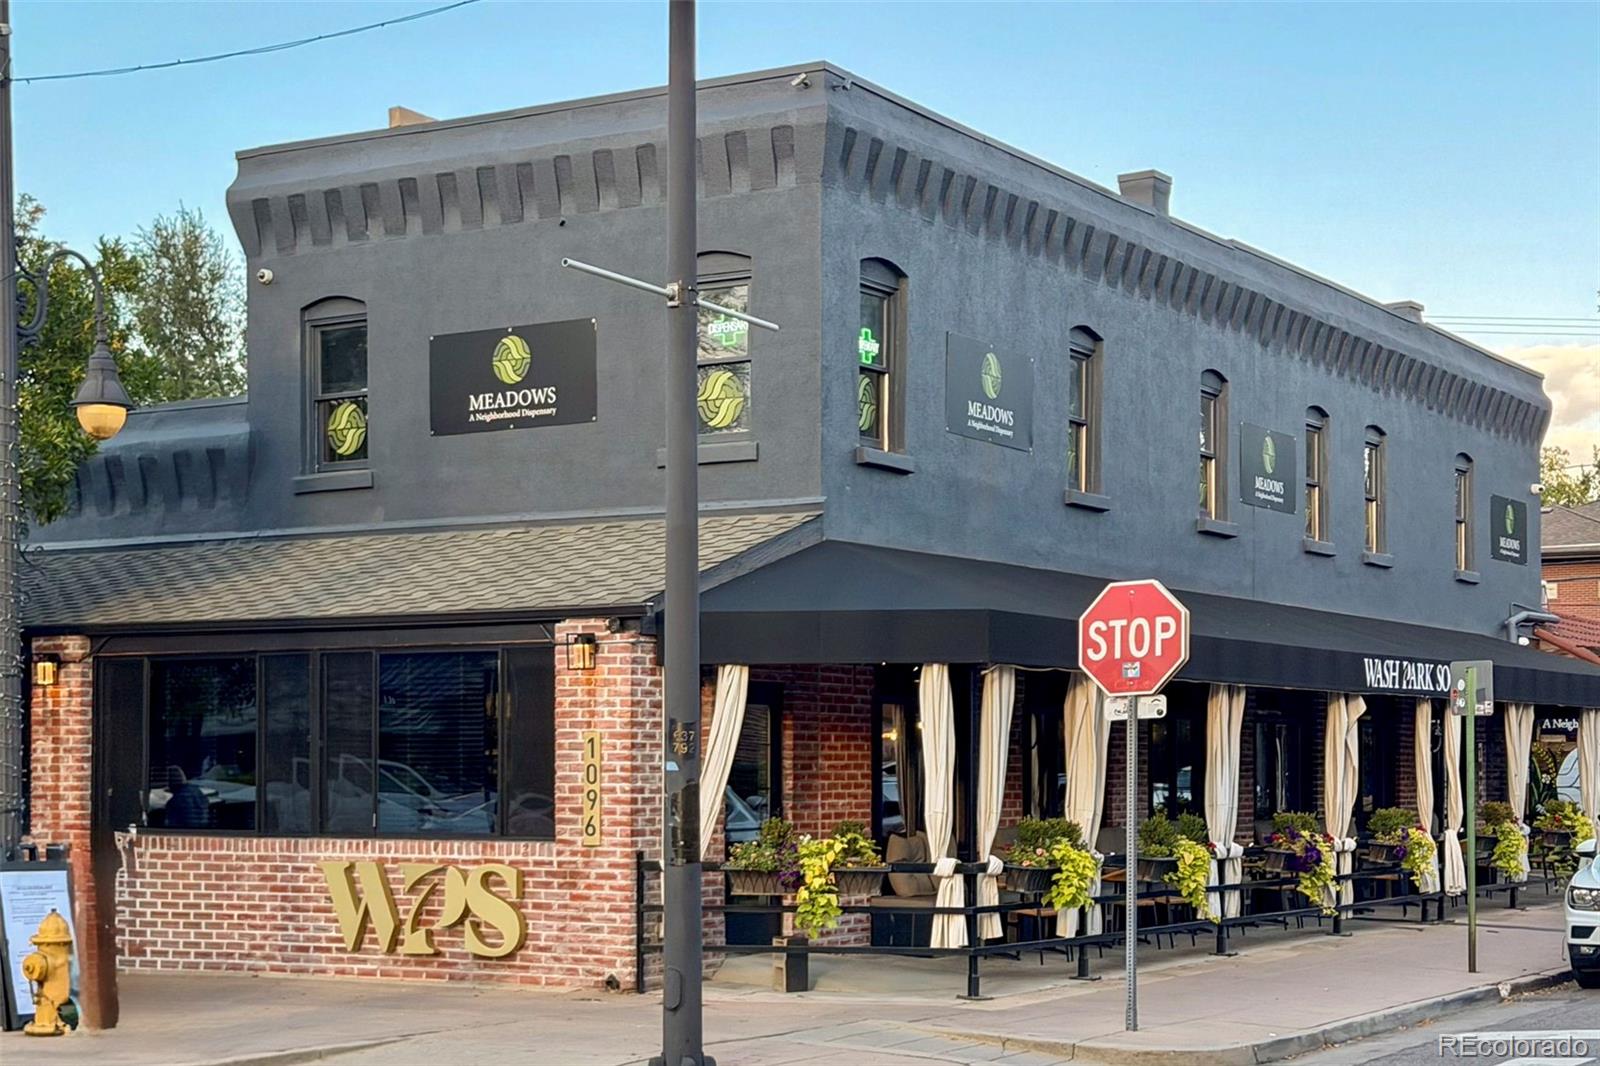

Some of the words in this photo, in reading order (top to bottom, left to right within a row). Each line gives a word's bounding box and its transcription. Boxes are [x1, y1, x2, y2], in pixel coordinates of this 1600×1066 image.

[469, 386, 557, 411] MEADOWS
[468, 413, 475, 422] A
[476, 409, 521, 422] Neighborhood
[522, 407, 557, 418] Dispensary
[968, 400, 1014, 426] MEADOWS
[1086, 615, 1177, 662] STOP
[1363, 658, 1400, 688] WASH
[1402, 661, 1434, 691] PARK
[1436, 664, 1452, 692] SO
[1542, 718, 1551, 729] A
[585, 737, 598, 836] 1096
